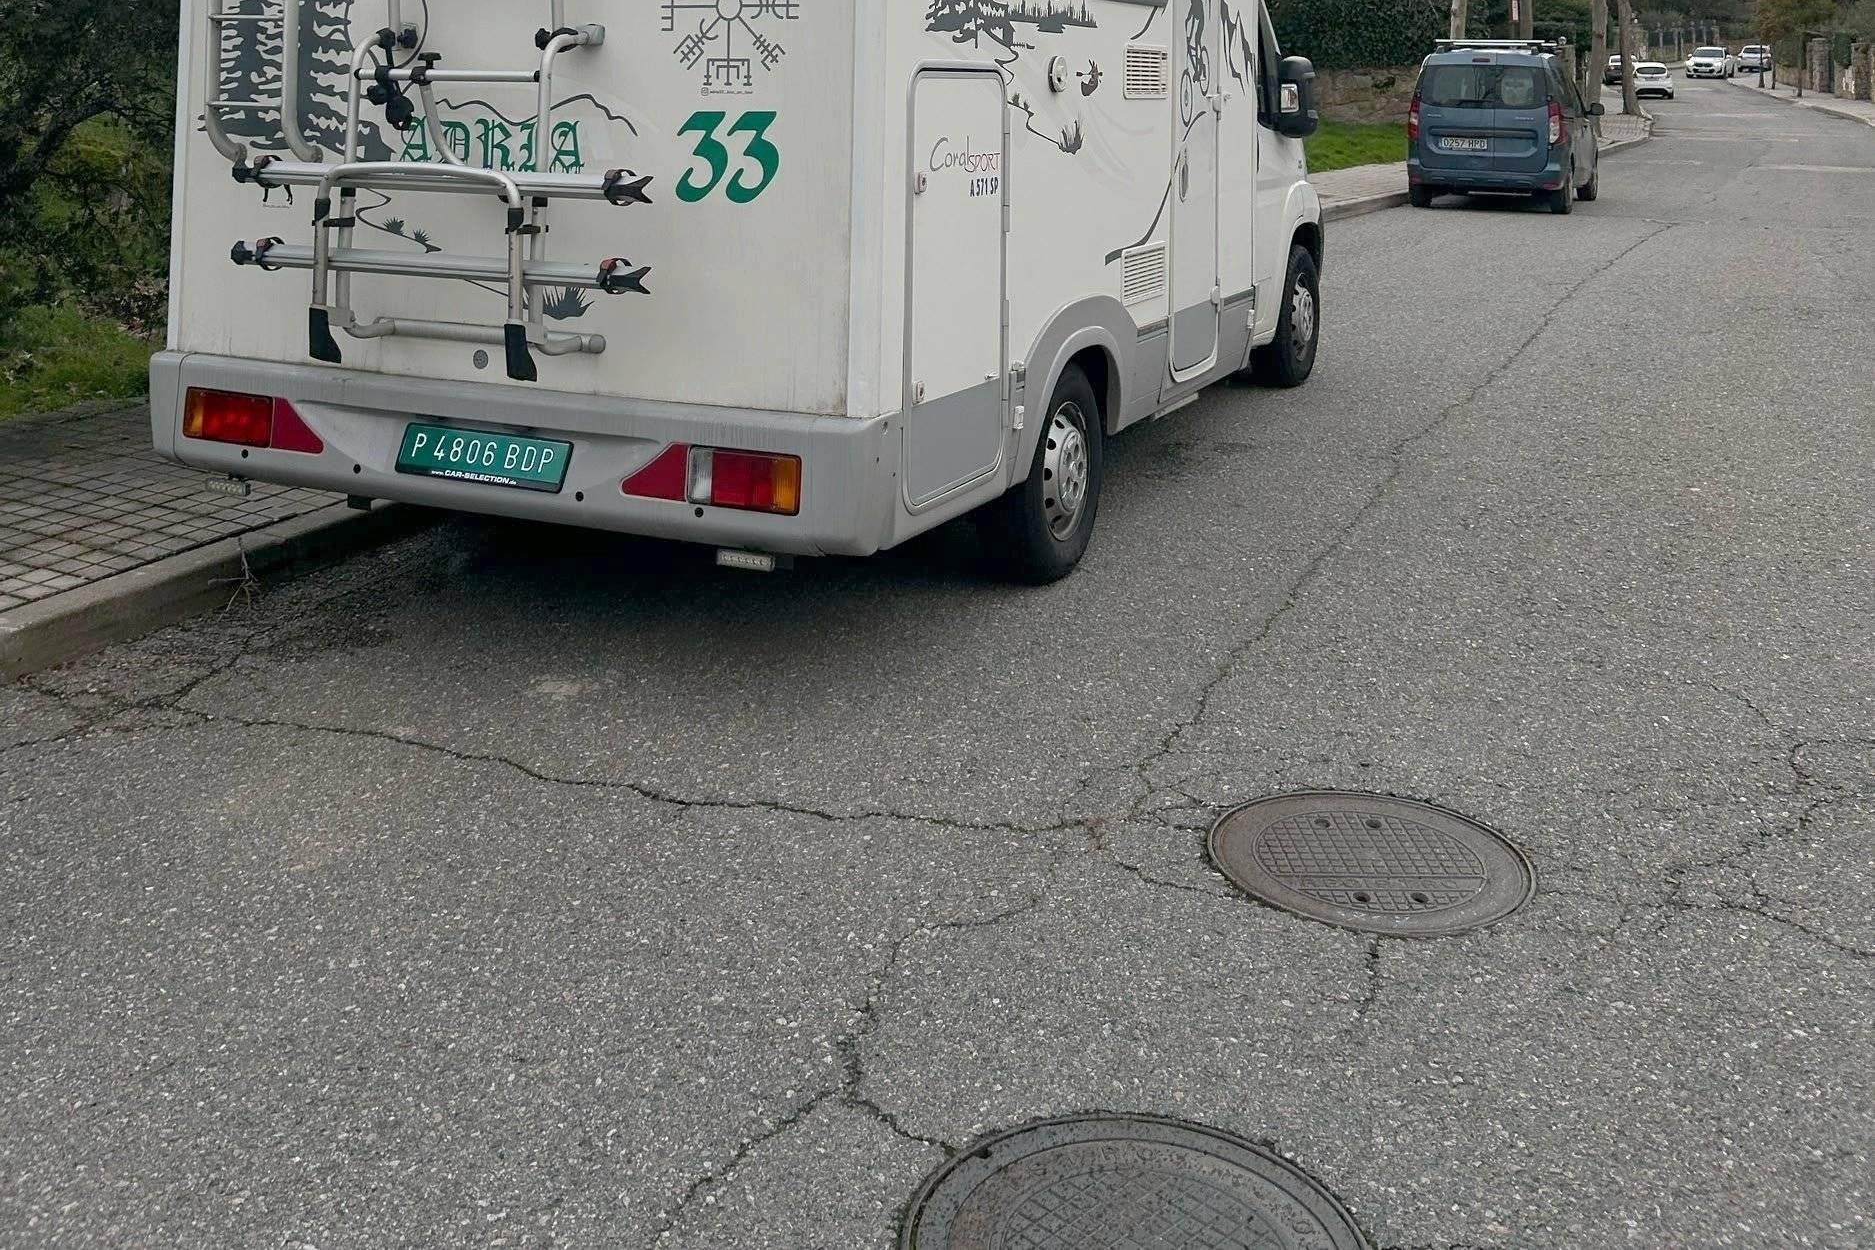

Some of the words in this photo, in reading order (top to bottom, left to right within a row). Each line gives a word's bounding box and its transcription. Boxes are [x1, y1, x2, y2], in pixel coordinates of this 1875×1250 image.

[400, 115, 585, 174] ADRIA
[675, 110, 780, 204] 33
[976, 178, 988, 197] 571
[411, 433, 427, 457] P
[433, 435, 498, 467] 4806
[503, 443, 554, 473] BDP
